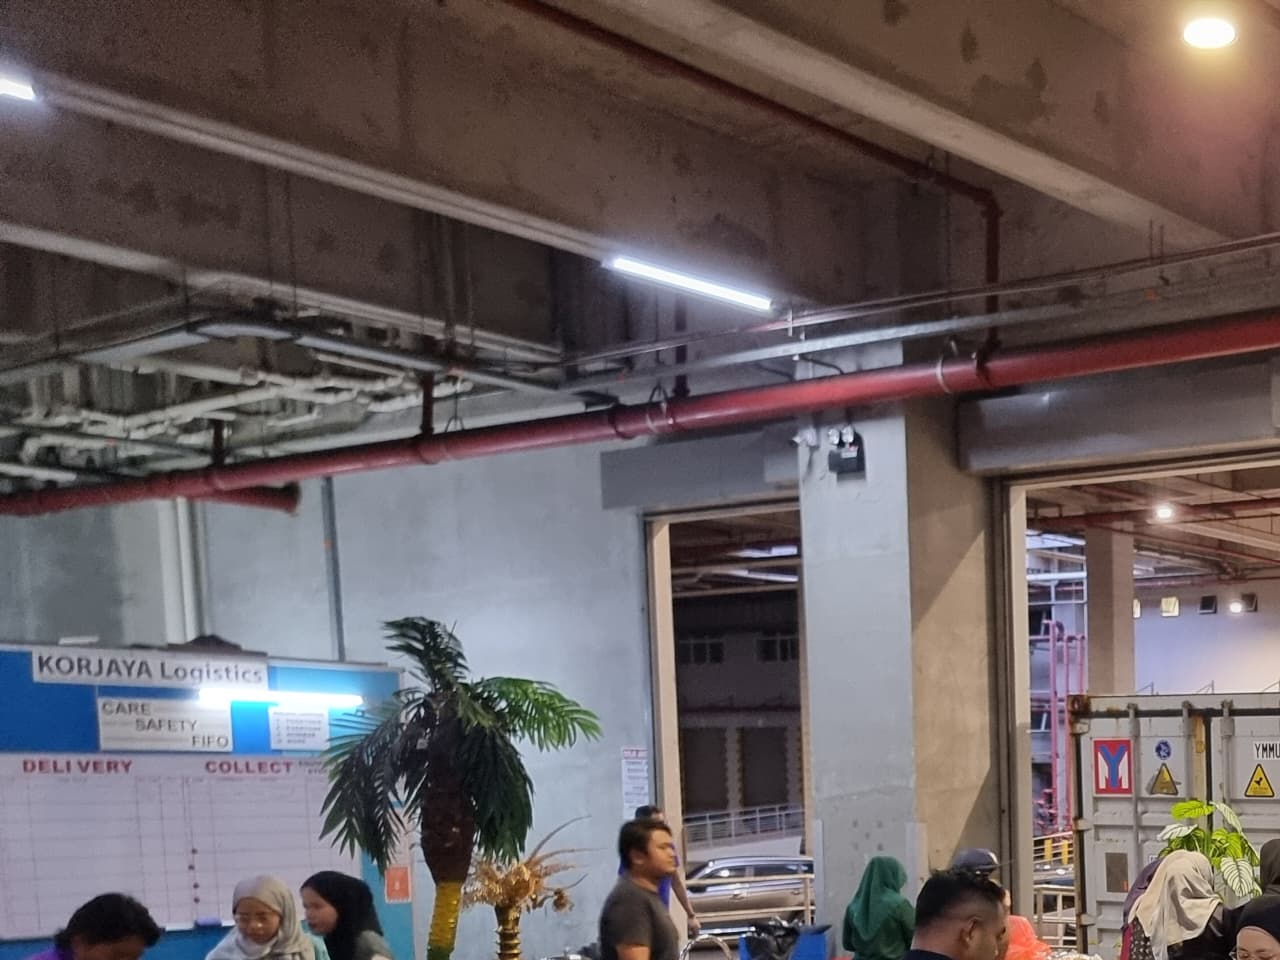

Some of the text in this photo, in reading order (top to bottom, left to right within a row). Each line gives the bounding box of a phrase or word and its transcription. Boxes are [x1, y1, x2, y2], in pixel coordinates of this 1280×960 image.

[38, 656, 263, 683] KORJAYA Logistics
[102, 702, 151, 715] CARE
[136, 719, 197, 732] SAFETY
[192, 735, 229, 748] FIFO
[205, 761, 293, 774] COLLECT
